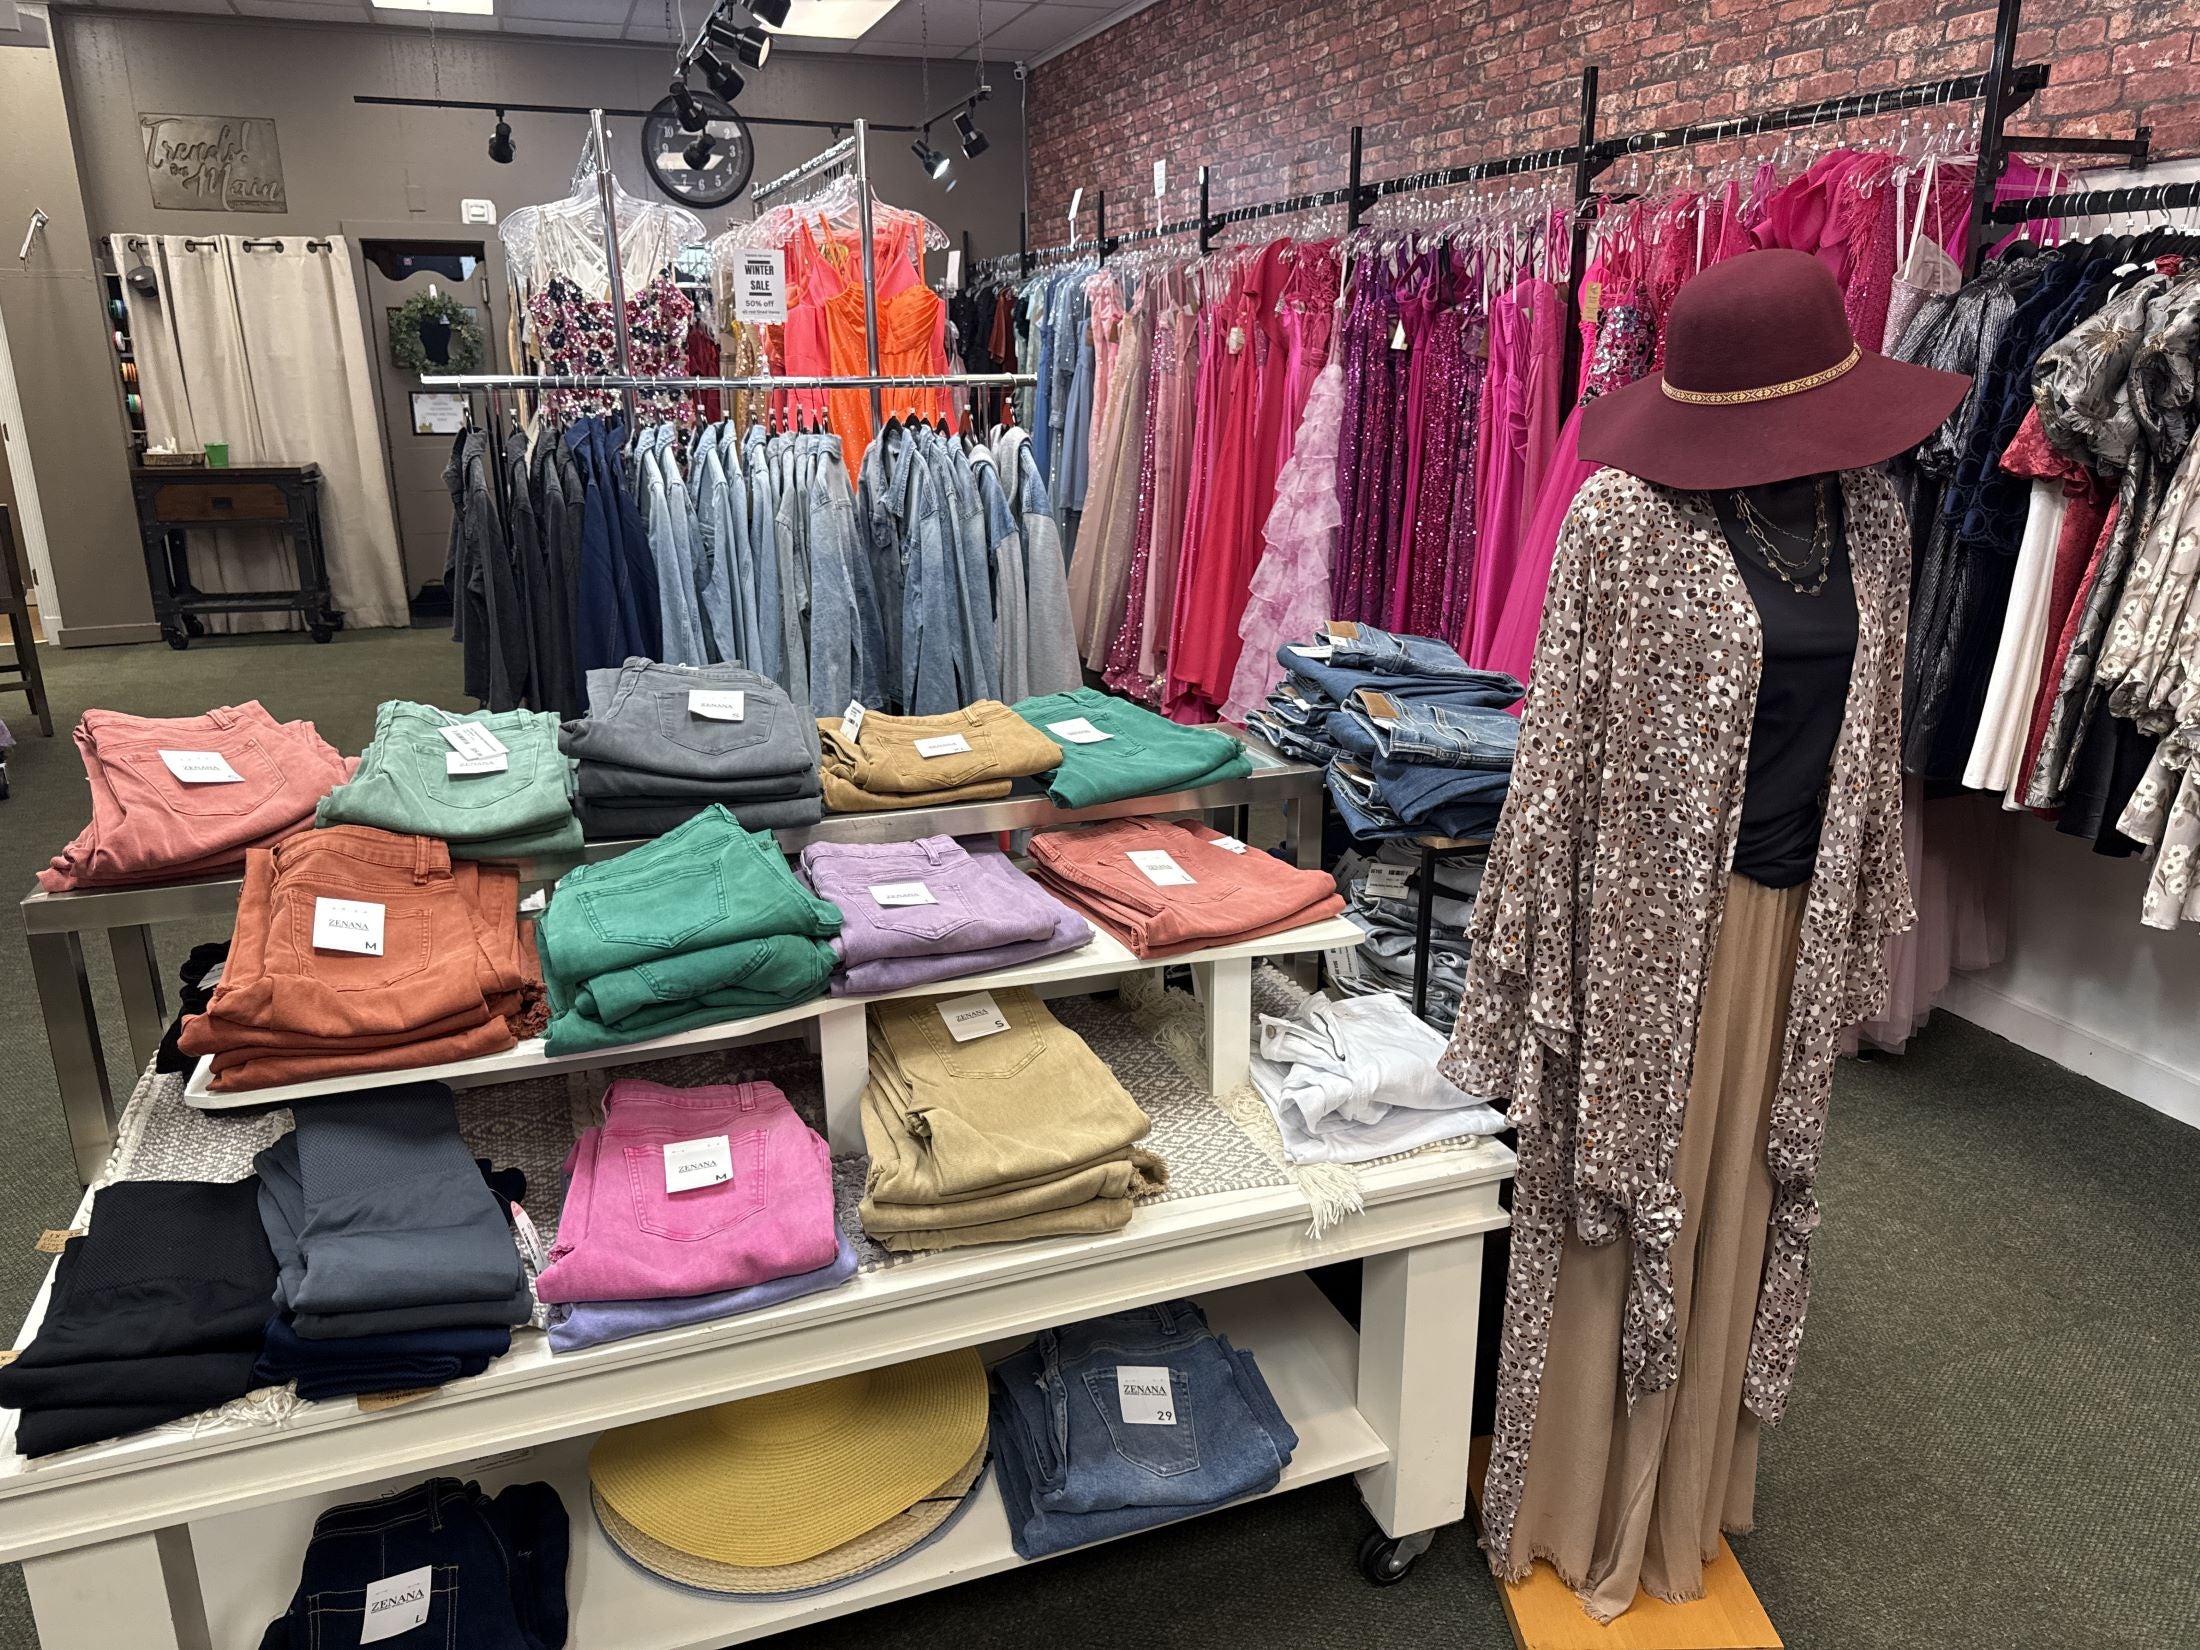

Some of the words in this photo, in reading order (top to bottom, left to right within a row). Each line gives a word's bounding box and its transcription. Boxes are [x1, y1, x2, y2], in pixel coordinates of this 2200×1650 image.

[664, 126, 674, 138] 10
[723, 128, 731, 139] 2
[141, 117, 250, 168] Trends!
[662, 143, 669, 154] 9
[729, 145, 736, 157] 3
[726, 163, 732, 174] 4
[681, 174, 687, 185] 7
[698, 179, 705, 190] 6
[715, 175, 721, 187] 5
[182, 162, 279, 211] Main
[744, 264, 774, 275] WINTER
[750, 280, 770, 291] SALE
[745, 300, 762, 308] 50%
[328, 918, 369, 931] ZENANA
[365, 941, 377, 951] M
[955, 1008, 989, 1021] ZENANA
[994, 1020, 1004, 1028] S
[678, 1160, 717, 1173] ZENANA
[716, 1173, 727, 1181] M
[1123, 1384, 1167, 1394] ZENANA
[1157, 1410, 1172, 1421] 29
[371, 1588, 424, 1612] ZENANA
[415, 1614, 424, 1624] L
